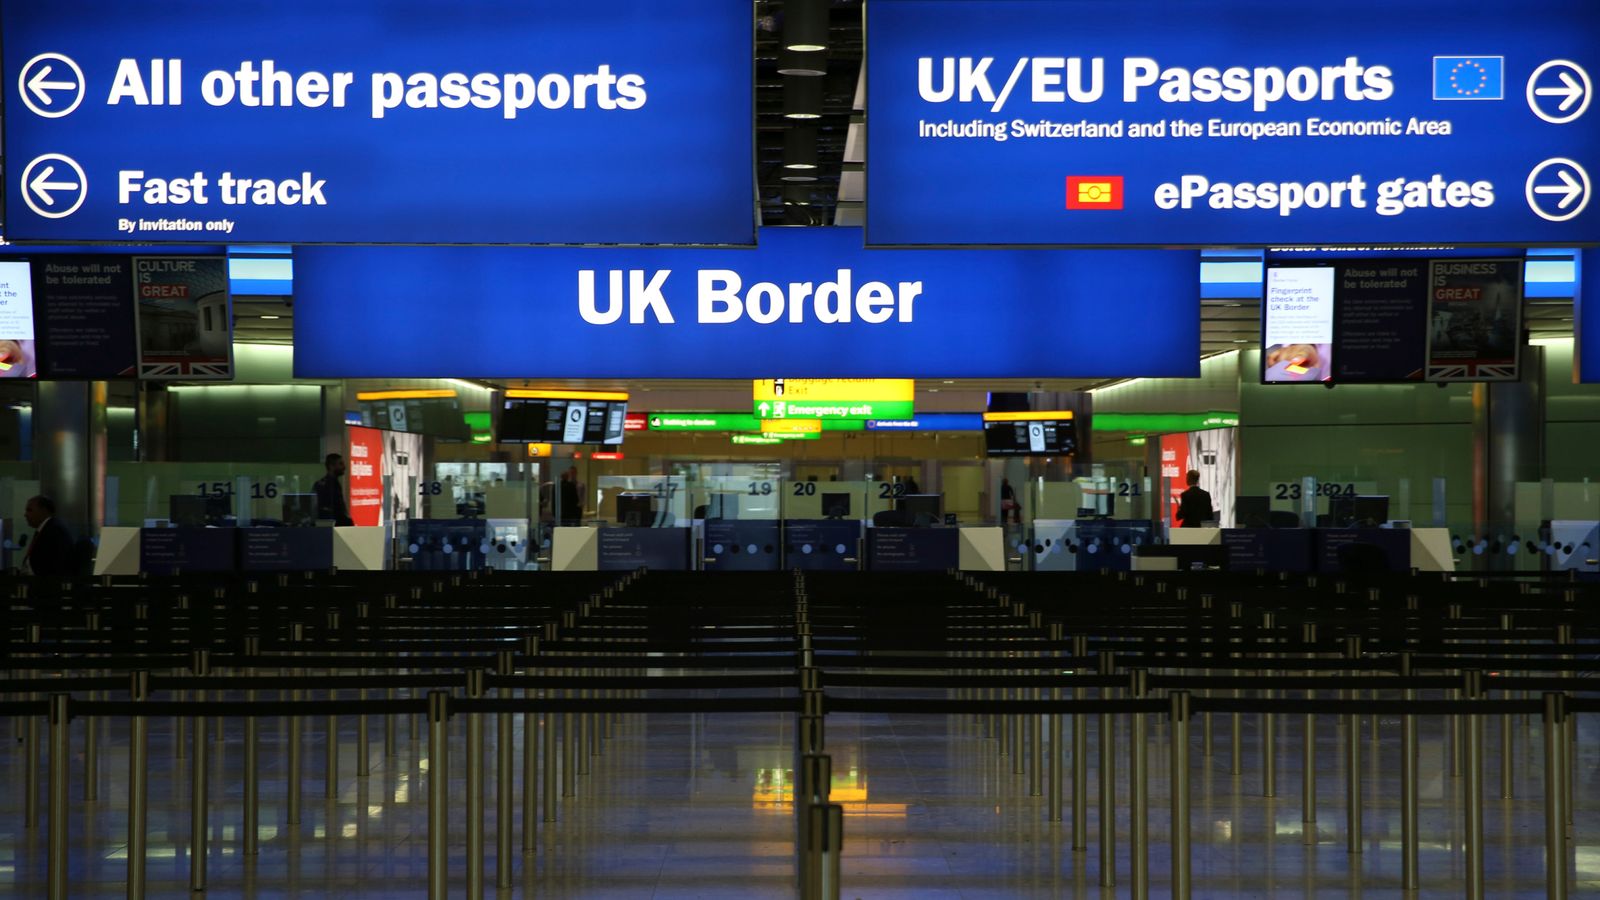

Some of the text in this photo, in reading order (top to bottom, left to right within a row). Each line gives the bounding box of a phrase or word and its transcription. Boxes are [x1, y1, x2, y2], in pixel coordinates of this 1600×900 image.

[106, 58, 647, 120] All other passports
[918, 56, 1394, 113] UK/EU Passports
[919, 117, 1452, 142] Including Switzerland and the European Economic Area
[118, 170, 327, 206] Fast track
[1154, 174, 1495, 217] ePassport gates
[118, 218, 235, 234] By invitation only
[46, 264, 122, 273] Abuse will not
[138, 261, 196, 272] CULTURE
[1344, 268, 1418, 278] Abuse will not
[1434, 263, 1497, 275] BUSINESS
[46, 275, 112, 285] be tolerated
[139, 272, 151, 283] IS
[1344, 279, 1407, 289] be tolerated
[1434, 275, 1447, 287] IS
[142, 286, 187, 297] GREAT
[578, 268, 923, 325] UK Border
[1271, 287, 1312, 296] Fingerprint
[1435, 288, 1481, 300] GREAT
[1284, 303, 1310, 311] Border
[788, 386, 808, 395] Exit
[788, 404, 873, 417] Emergency exit
[250, 482, 278, 499] 16
[418, 482, 442, 496] 18
[654, 482, 679, 499] 17
[748, 481, 772, 496] 19
[793, 482, 816, 496] 20
[879, 482, 905, 499] 22
[1118, 482, 1142, 497] 21
[1275, 483, 1301, 500] 23
